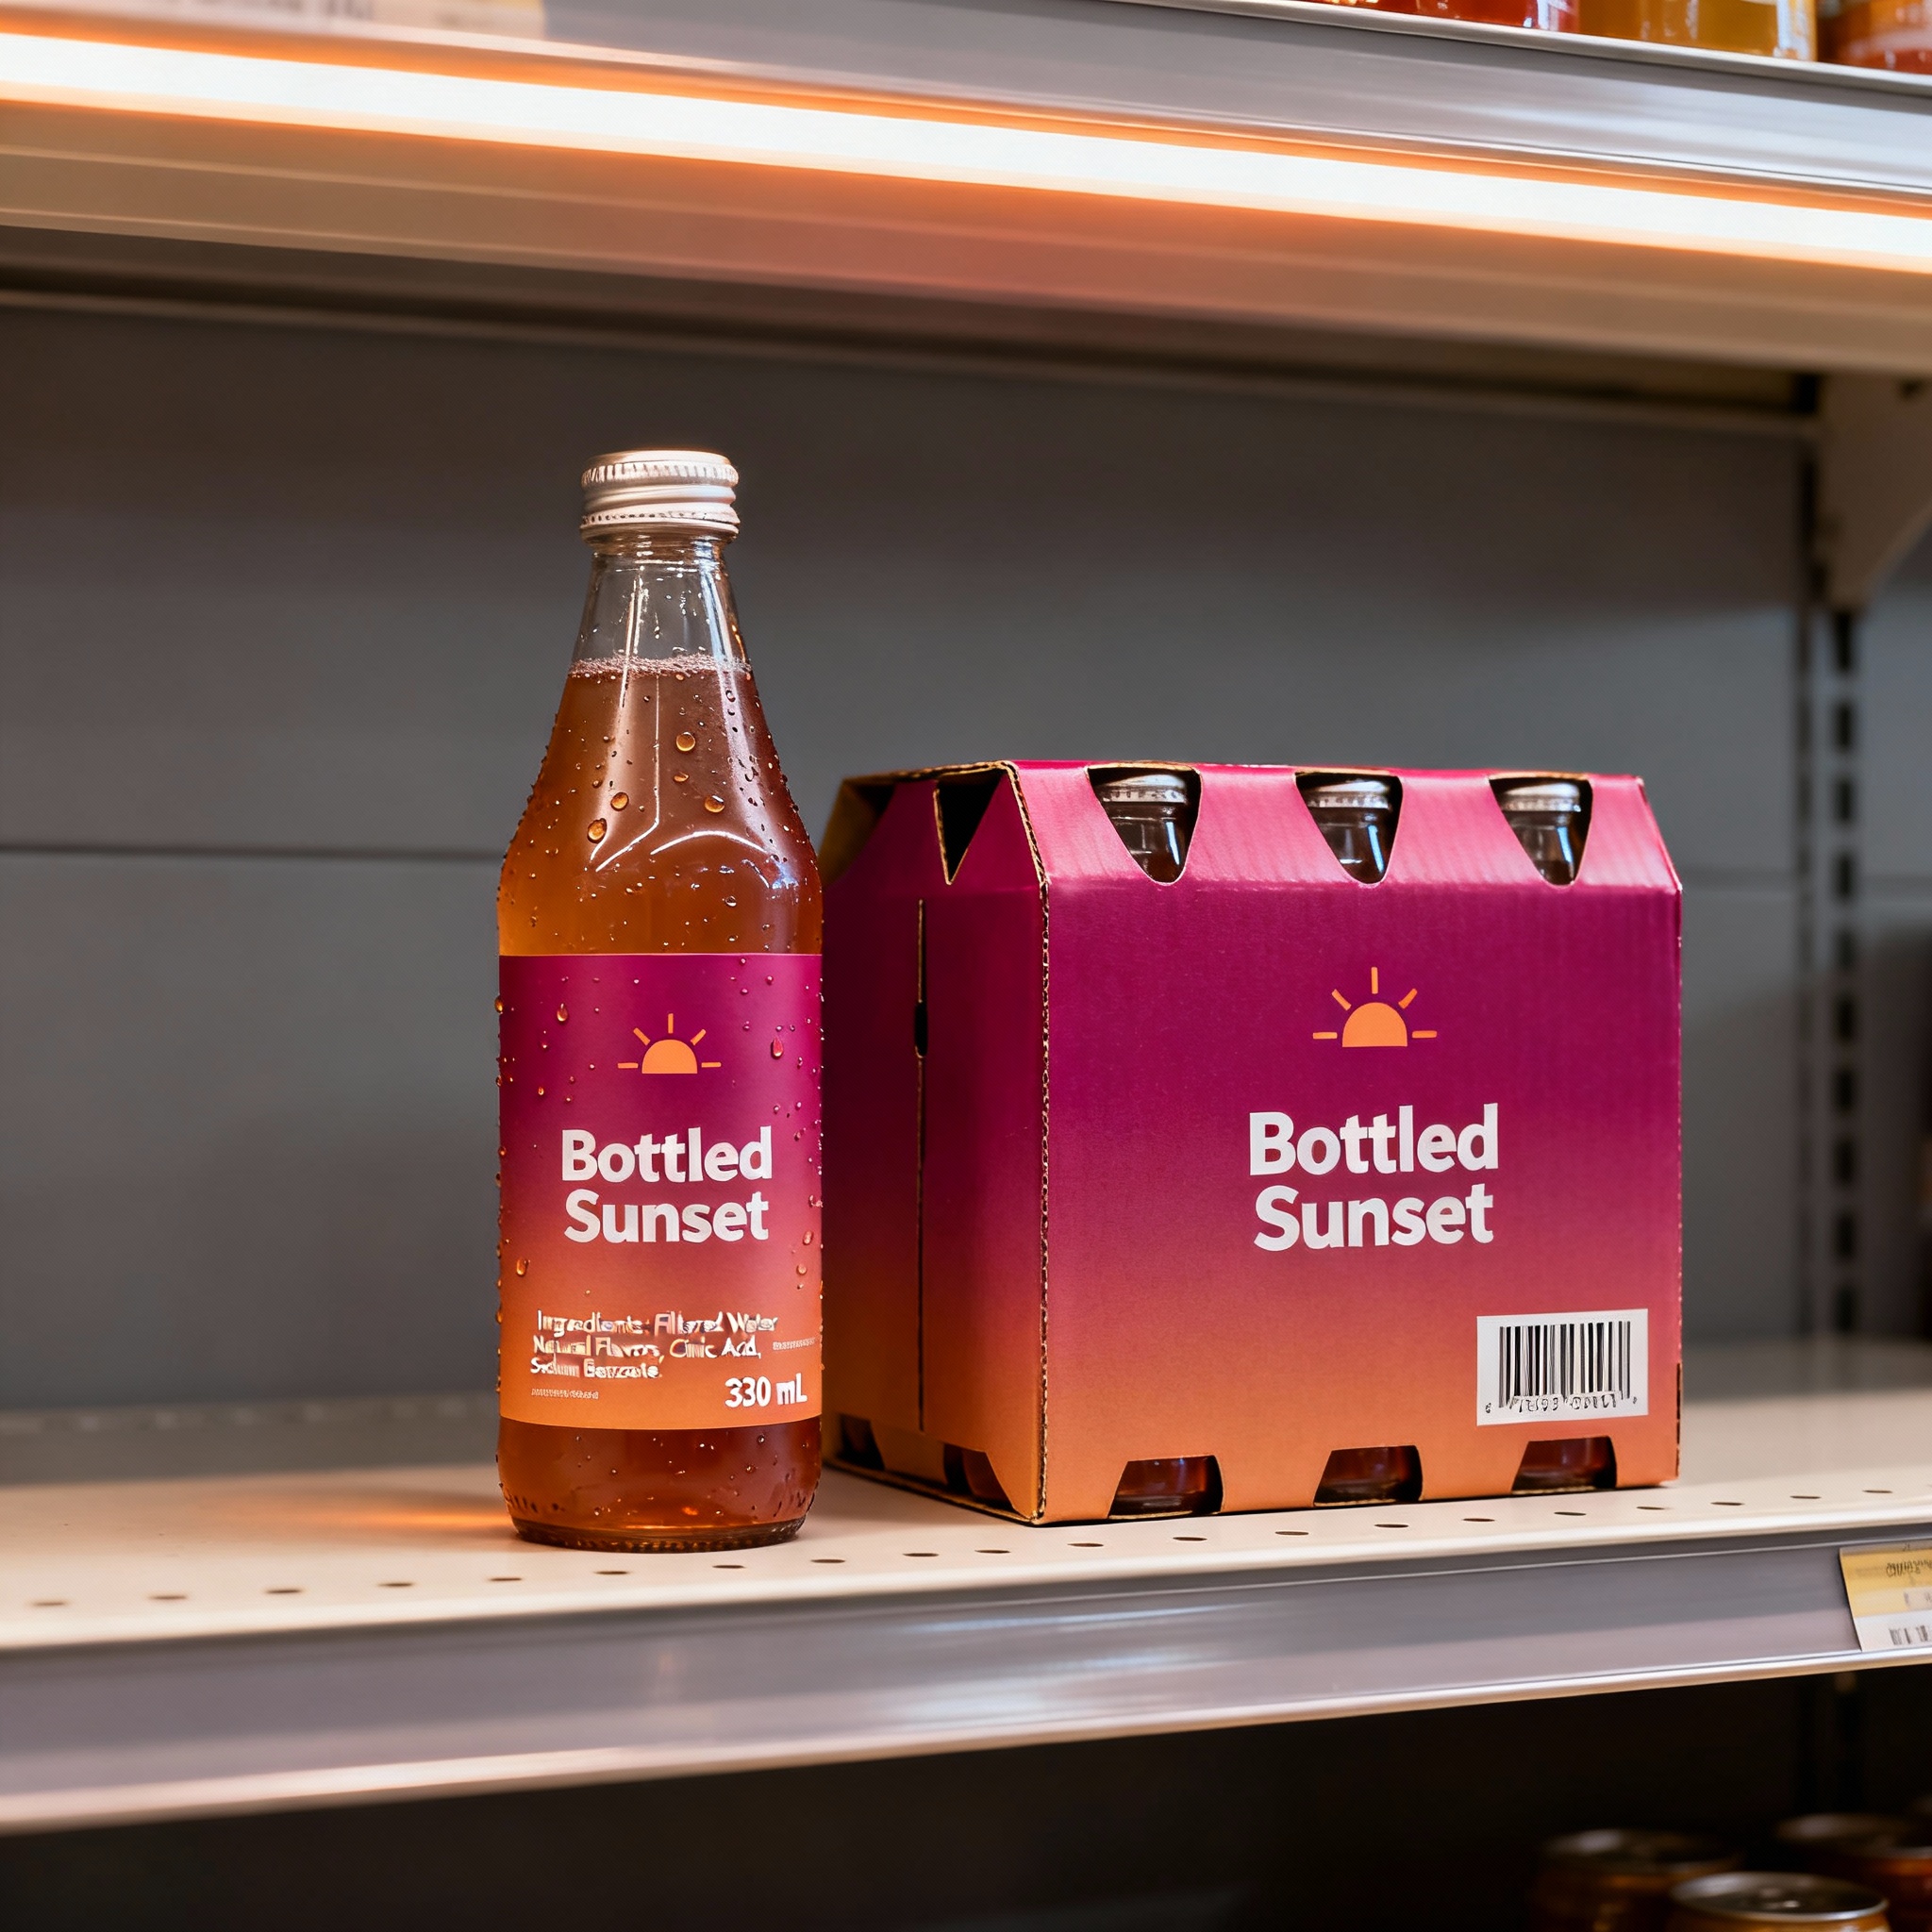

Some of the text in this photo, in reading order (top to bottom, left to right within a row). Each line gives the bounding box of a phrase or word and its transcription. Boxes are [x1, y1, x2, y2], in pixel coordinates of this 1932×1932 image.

[561, 1125, 773, 1183] Bottled
[1249, 1103, 1499, 1176] Bottled
[564, 1189, 770, 1243] Sunset
[1253, 1183, 1494, 1252] Sunset
[724, 1373, 808, 1408] 330 mL
